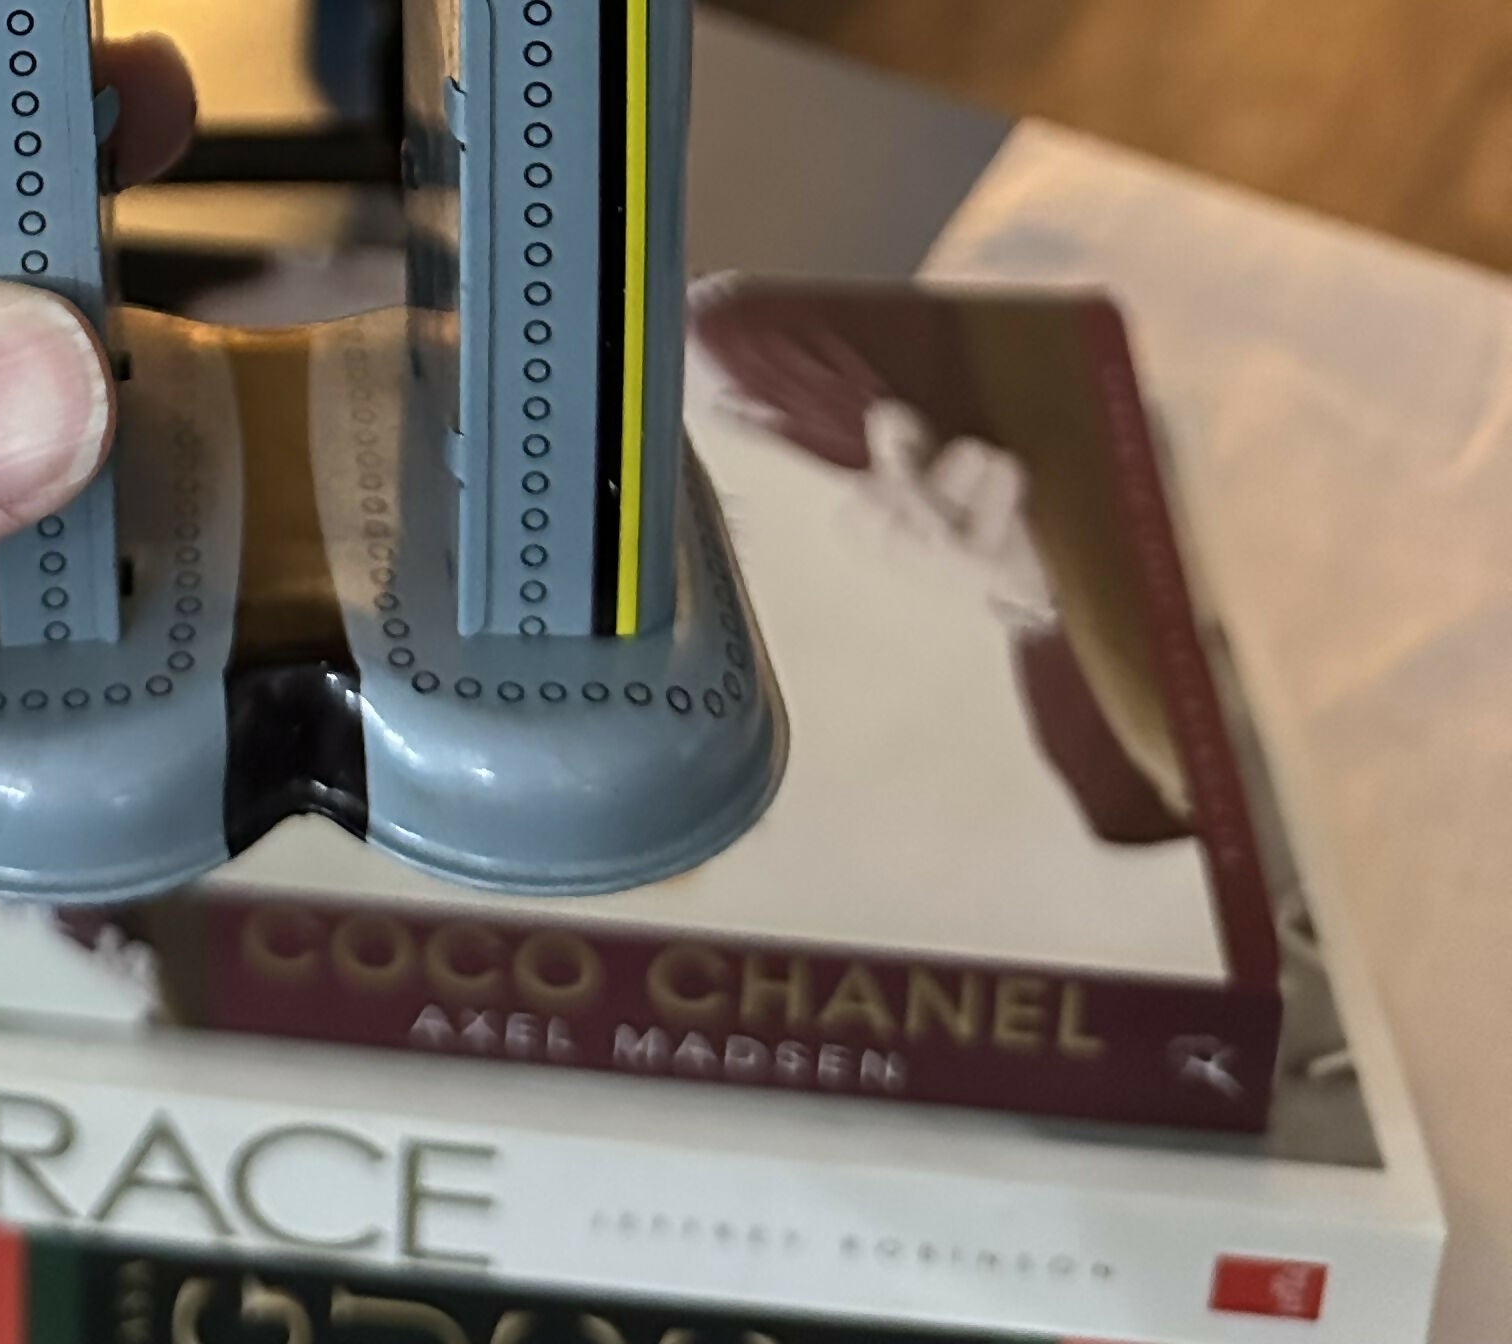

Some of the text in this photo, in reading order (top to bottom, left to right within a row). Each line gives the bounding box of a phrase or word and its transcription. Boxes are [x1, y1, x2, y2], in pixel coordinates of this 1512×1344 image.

[244, 912, 1104, 1056] COCO CHANEL
[411, 1004, 906, 1090] AXEL MADSEN
